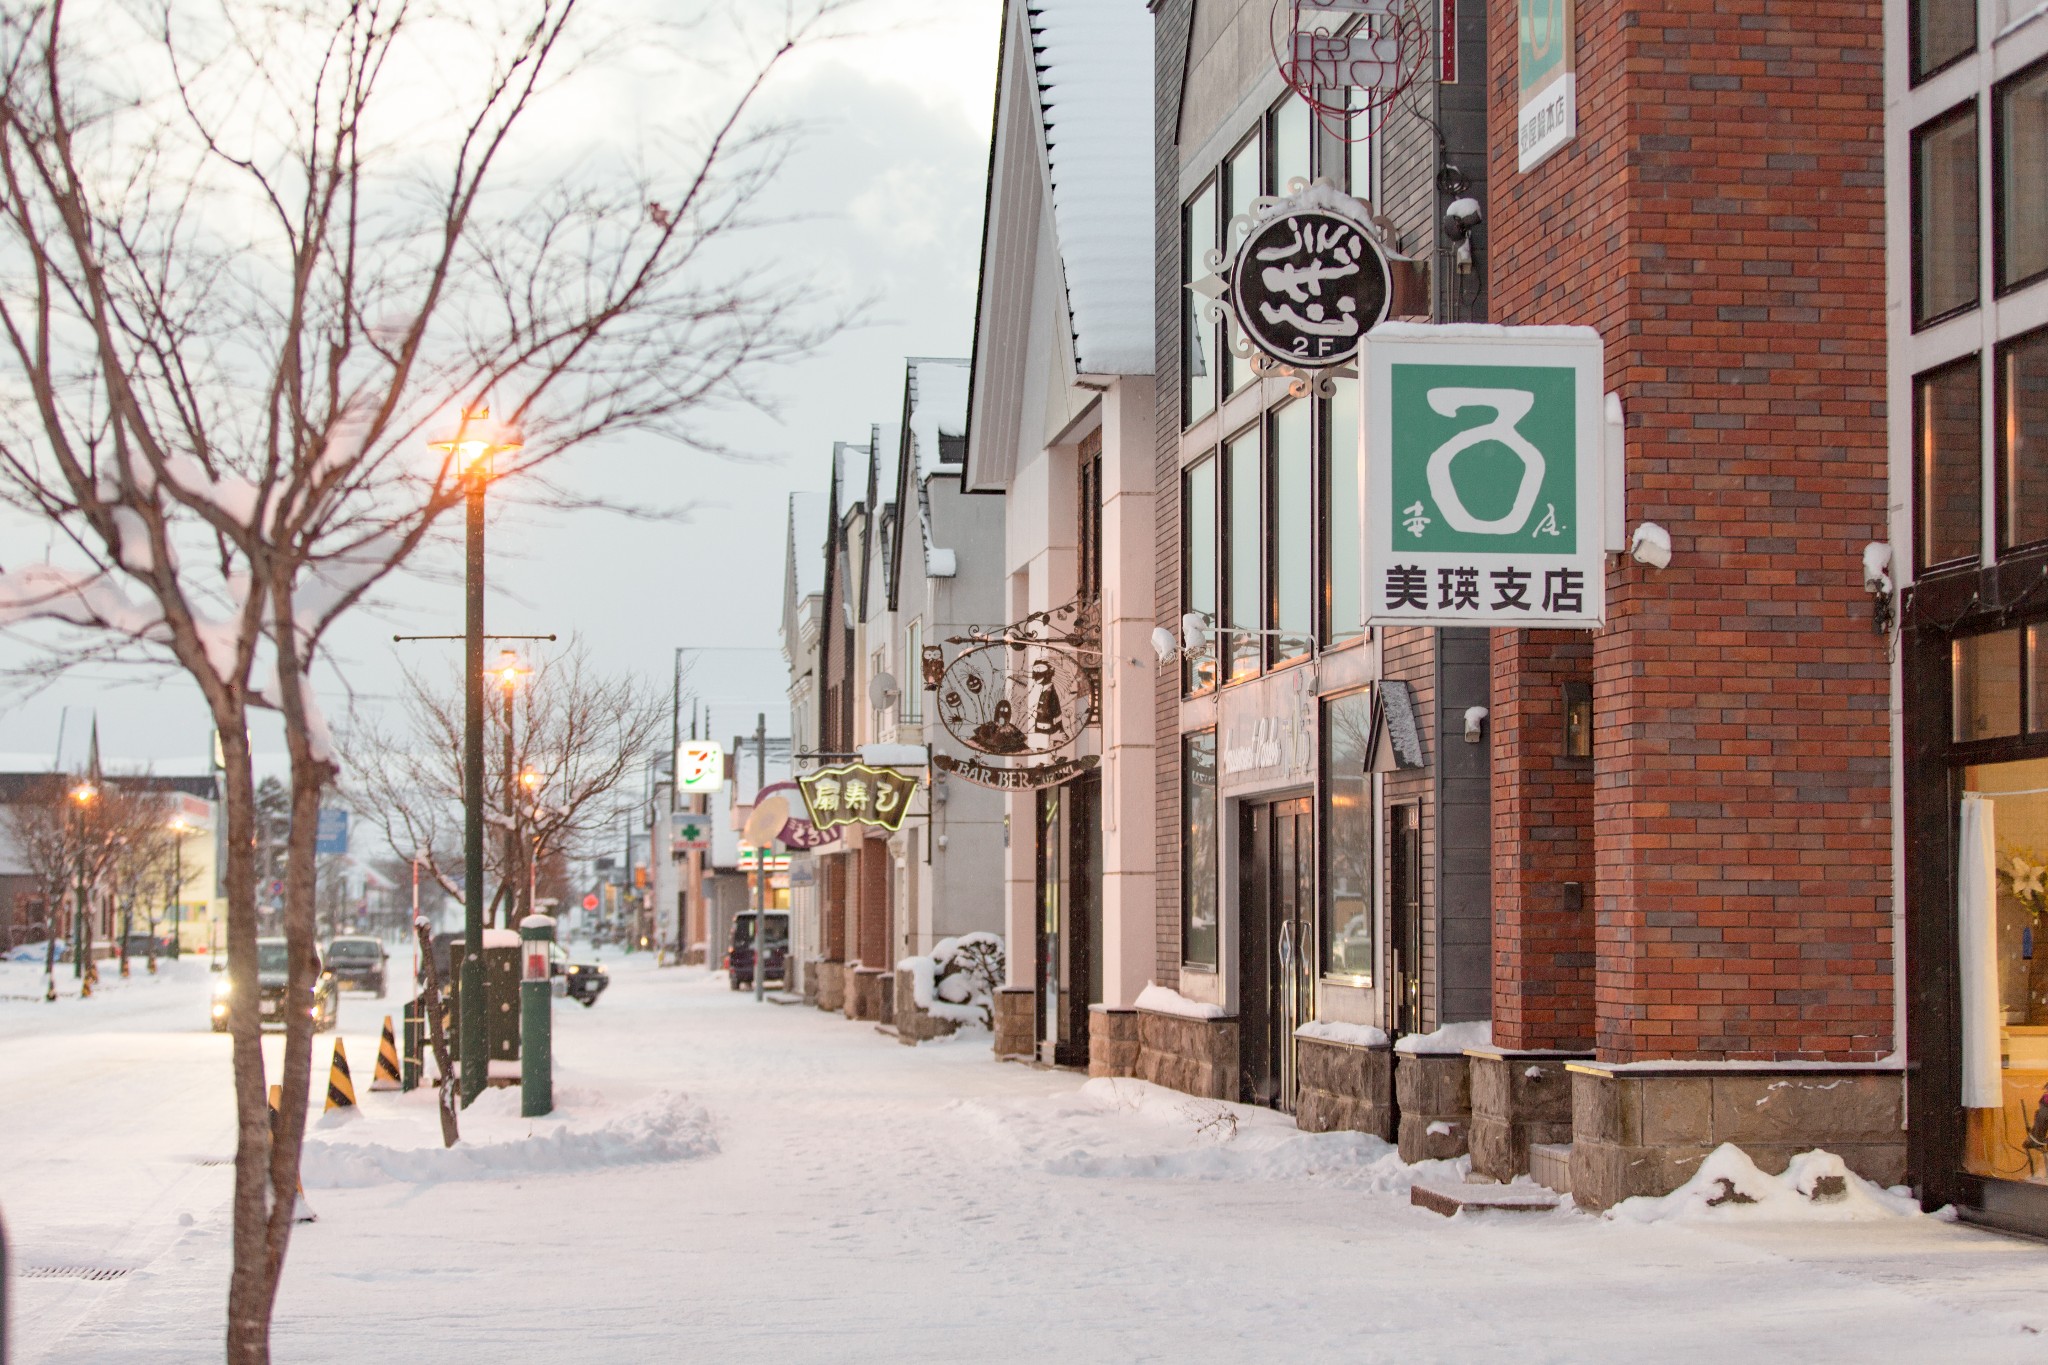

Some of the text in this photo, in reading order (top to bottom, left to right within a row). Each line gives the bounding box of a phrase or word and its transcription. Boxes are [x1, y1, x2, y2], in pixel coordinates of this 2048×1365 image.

[1292, 336, 1334, 356] 2F
[1385, 564, 1584, 613] 美瑛支店
